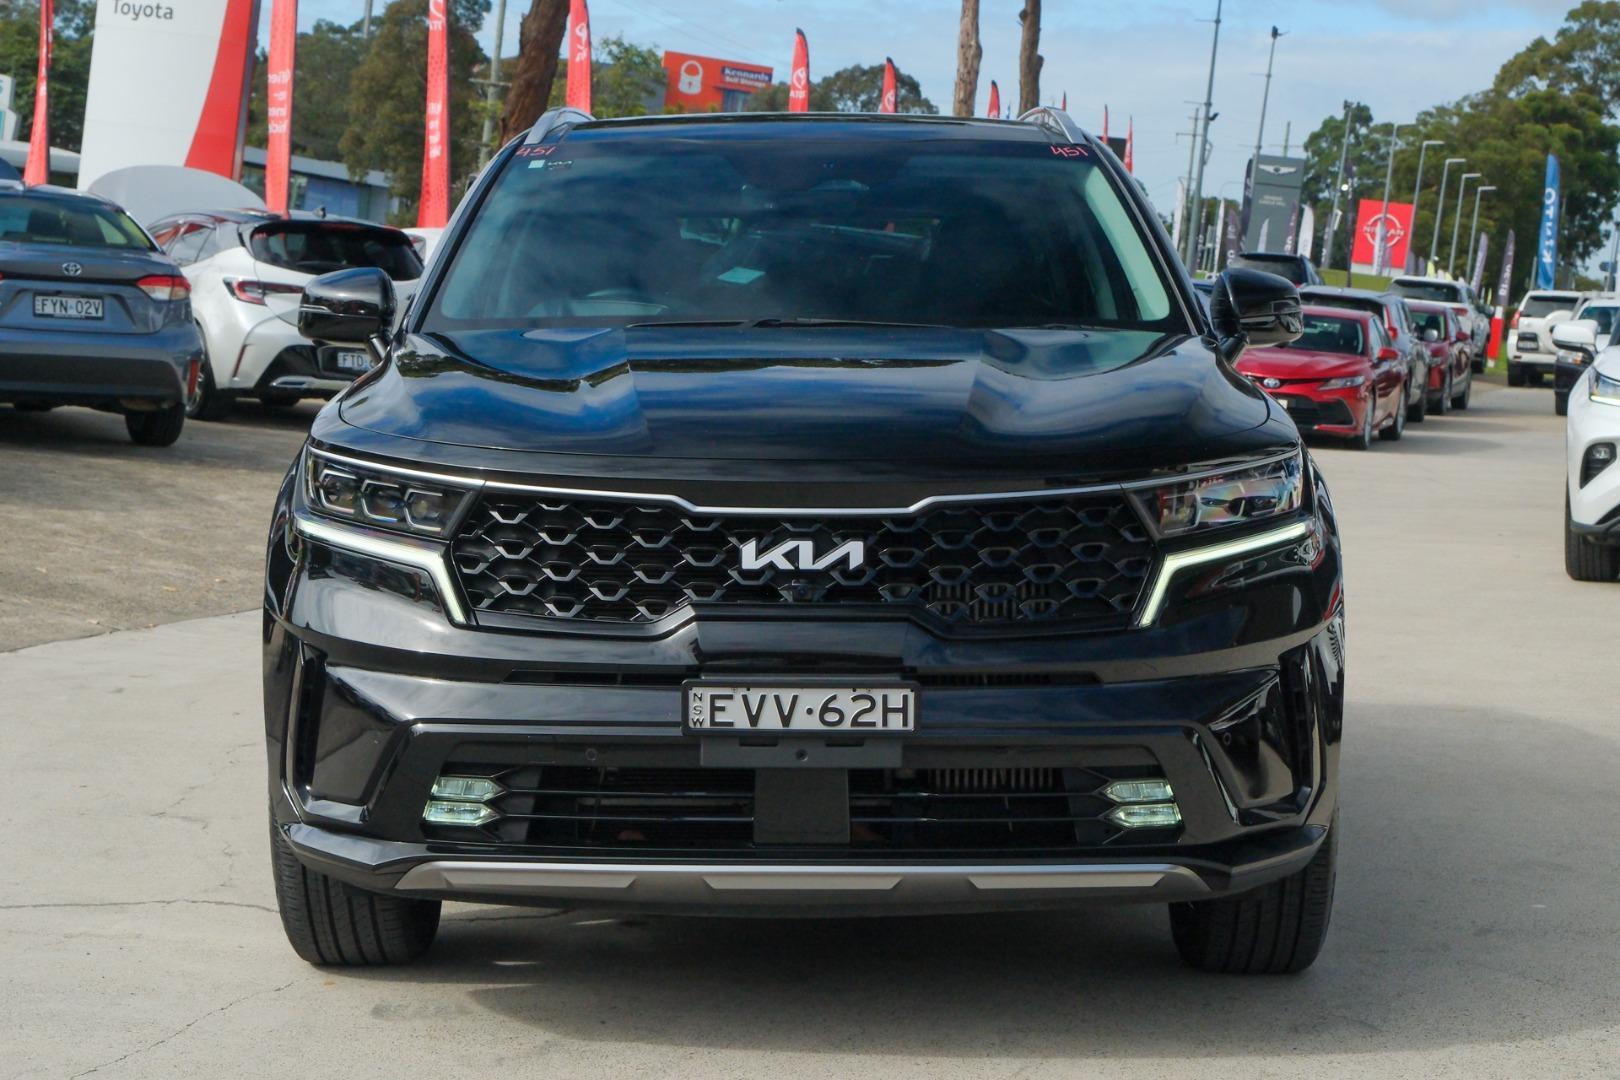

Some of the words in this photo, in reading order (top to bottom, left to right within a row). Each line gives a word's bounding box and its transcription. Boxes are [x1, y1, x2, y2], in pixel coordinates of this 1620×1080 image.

[113, 0, 174, 21] Toyota
[724, 66, 770, 81] Kennards
[1050, 145, 1089, 157] 451
[741, 538, 864, 570] KIA
